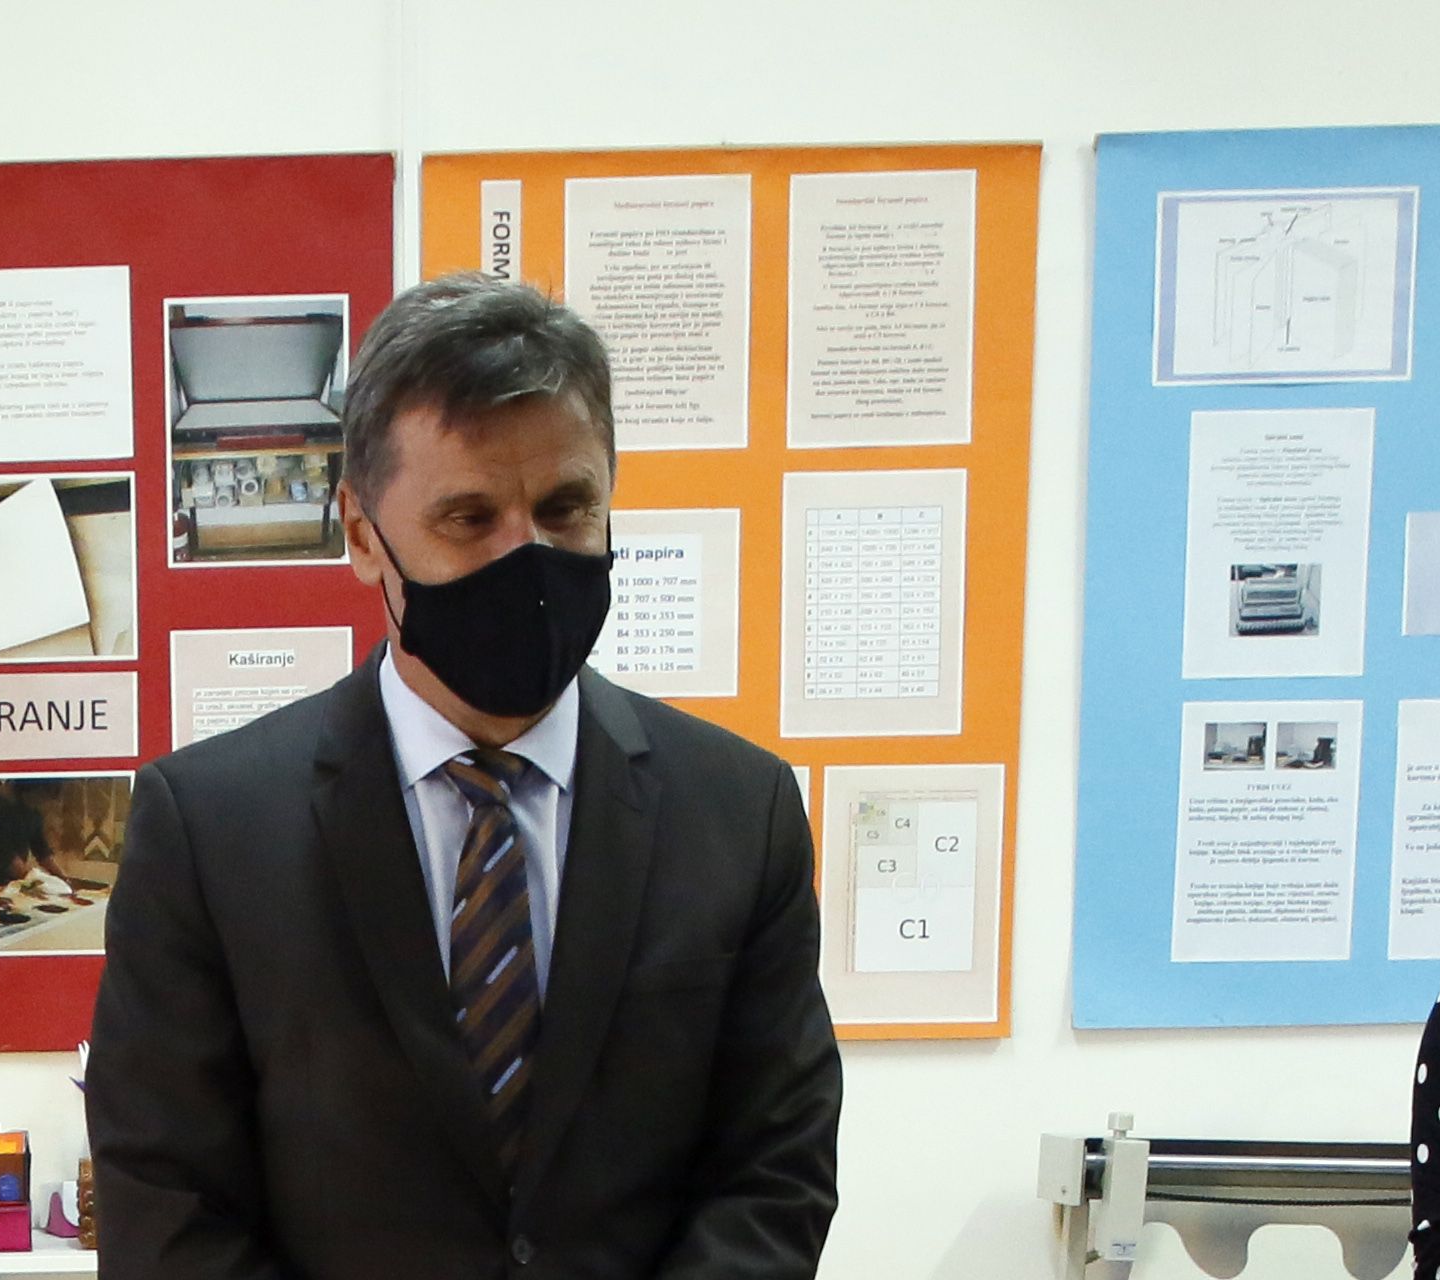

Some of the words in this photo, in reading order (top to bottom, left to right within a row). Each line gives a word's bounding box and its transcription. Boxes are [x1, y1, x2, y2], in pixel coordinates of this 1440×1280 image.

[492, 210, 511, 280] FORM
[611, 547, 629, 559] ati
[635, 546, 684, 561] papira
[229, 651, 295, 668] Kaširanje
[894, 818, 911, 830] C4
[934, 836, 960, 853] C2
[877, 859, 898, 873] C3
[898, 918, 930, 940] C1
